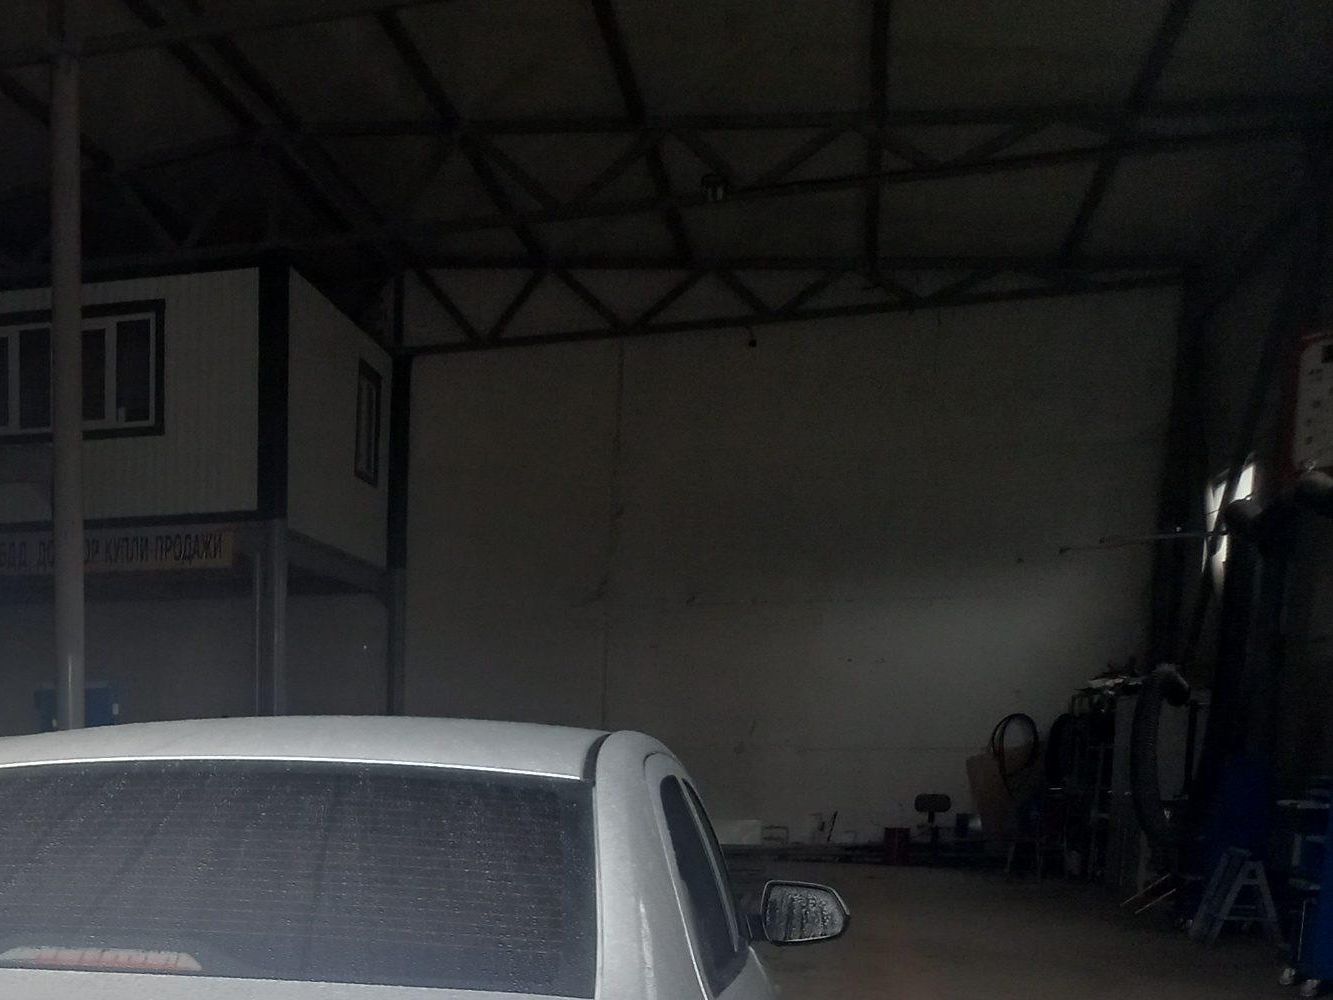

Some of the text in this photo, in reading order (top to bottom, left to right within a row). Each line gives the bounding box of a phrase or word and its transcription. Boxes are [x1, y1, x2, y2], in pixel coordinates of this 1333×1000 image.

[35, 537, 99, 573] ДООР
[105, 535, 150, 563] КУПЛИ
[155, 532, 223, 567] ПРОДАЖИ
